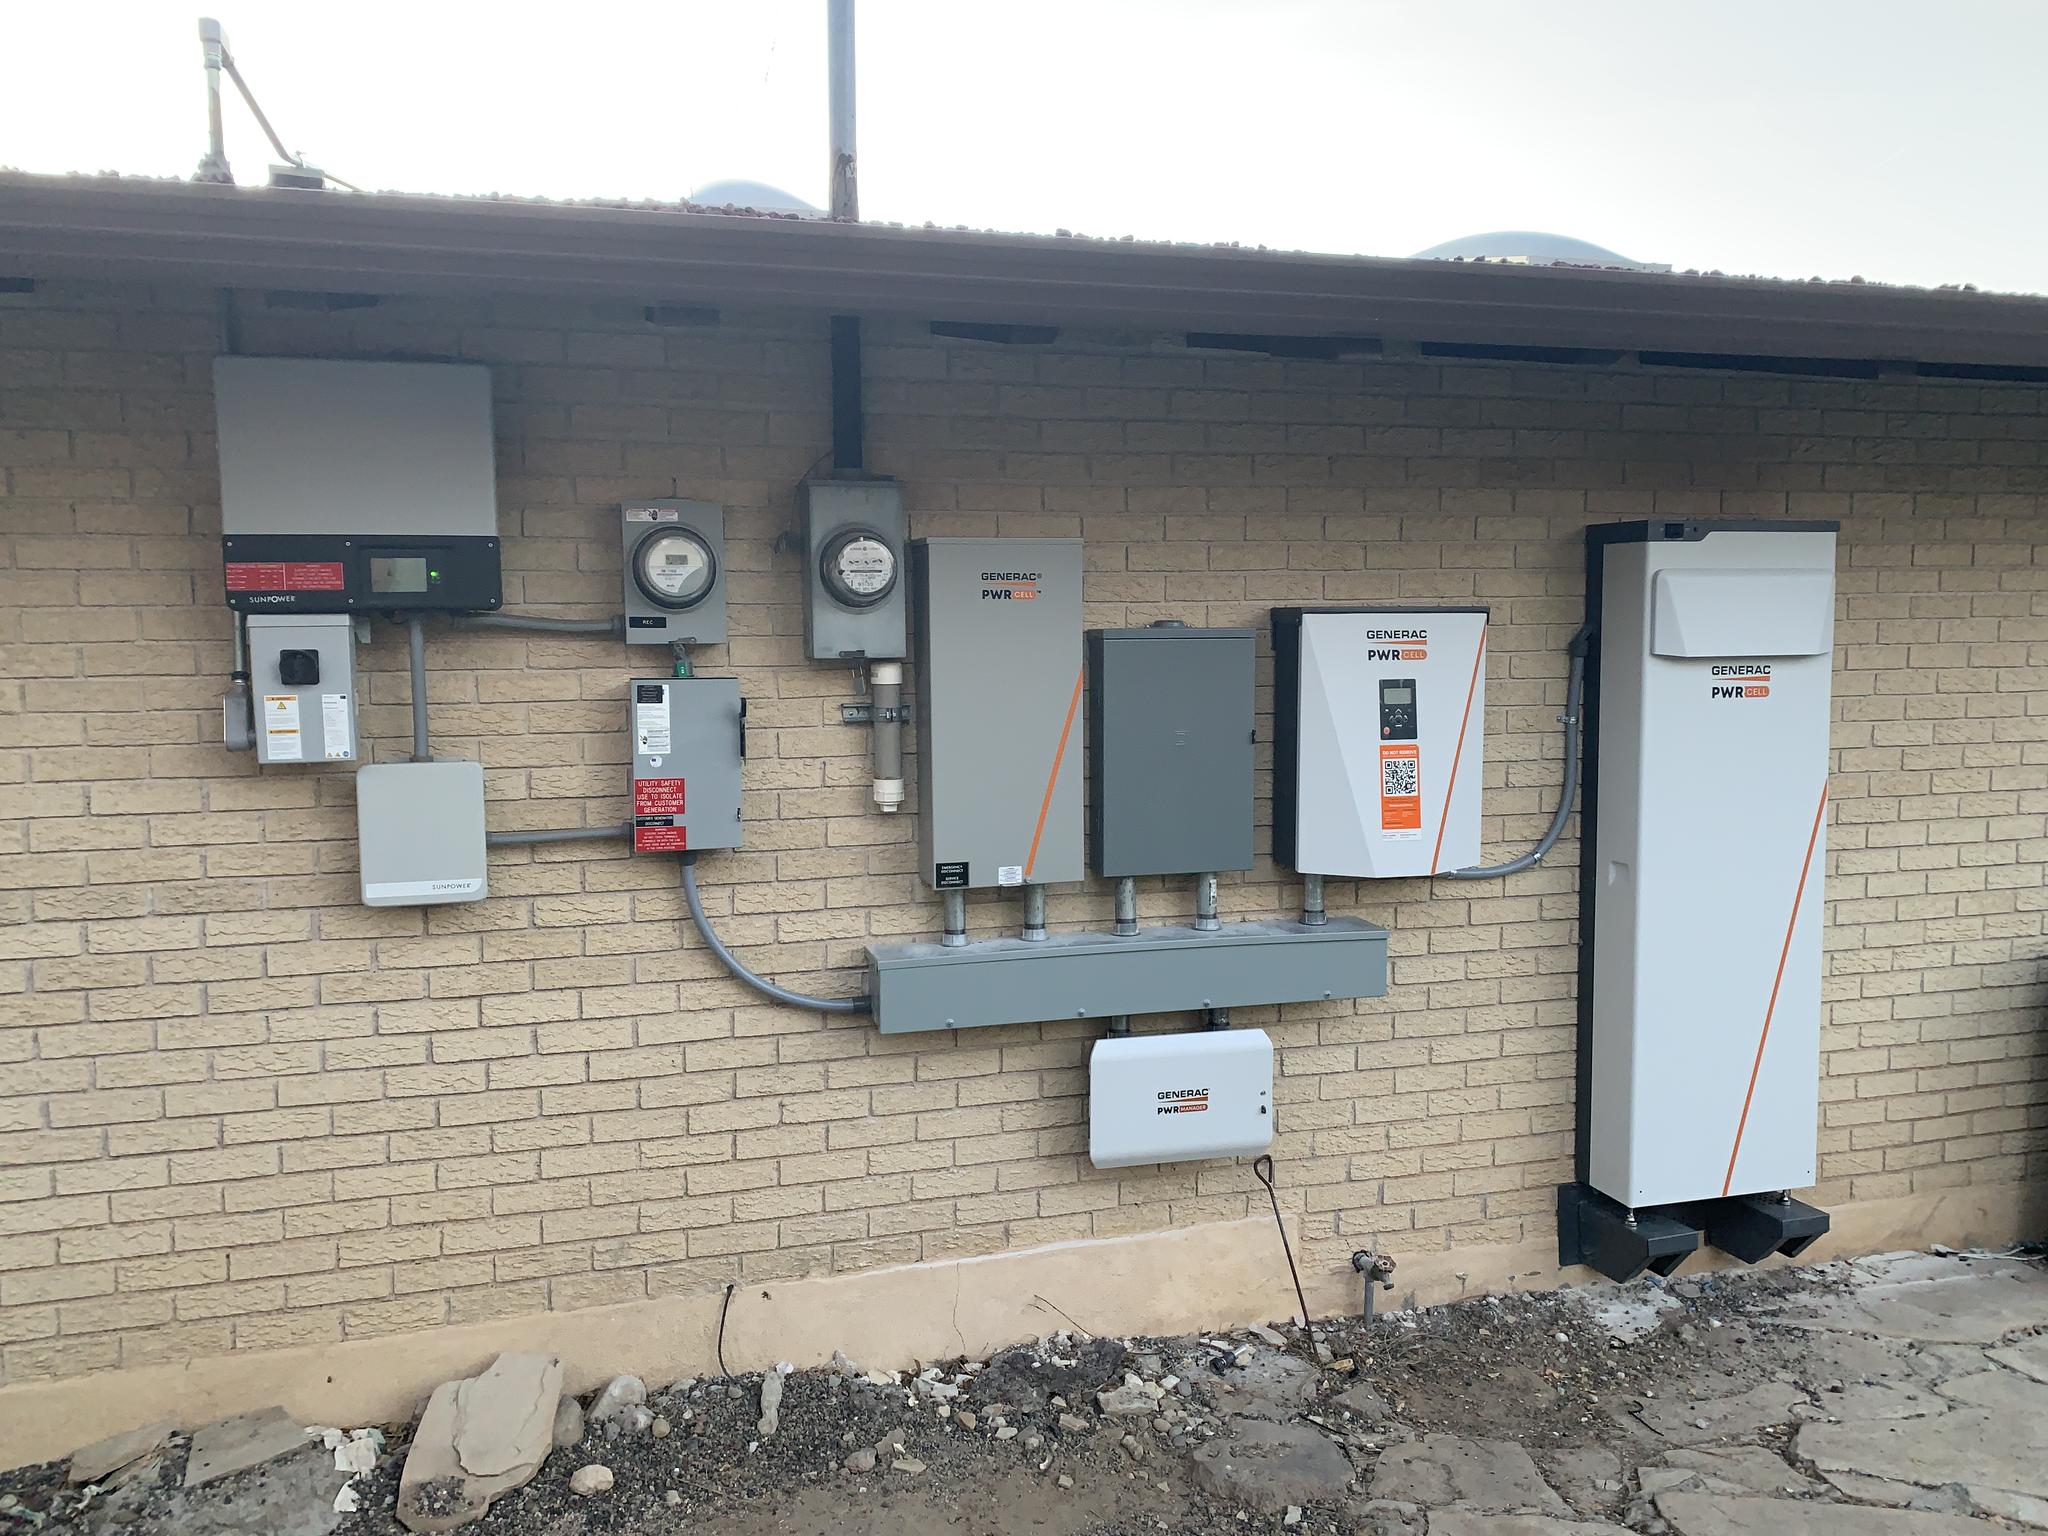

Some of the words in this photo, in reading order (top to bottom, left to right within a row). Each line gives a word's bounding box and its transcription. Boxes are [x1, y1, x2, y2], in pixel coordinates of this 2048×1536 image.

[981, 572, 1037, 581] GENERAC
[249, 596, 296, 604] SUNPOWER
[1366, 630, 1428, 639] GENERAC
[1711, 665, 1771, 676] GENERAC
[432, 882, 472, 890] SUNPOWER
[1157, 1088, 1209, 1100] GENERAC
